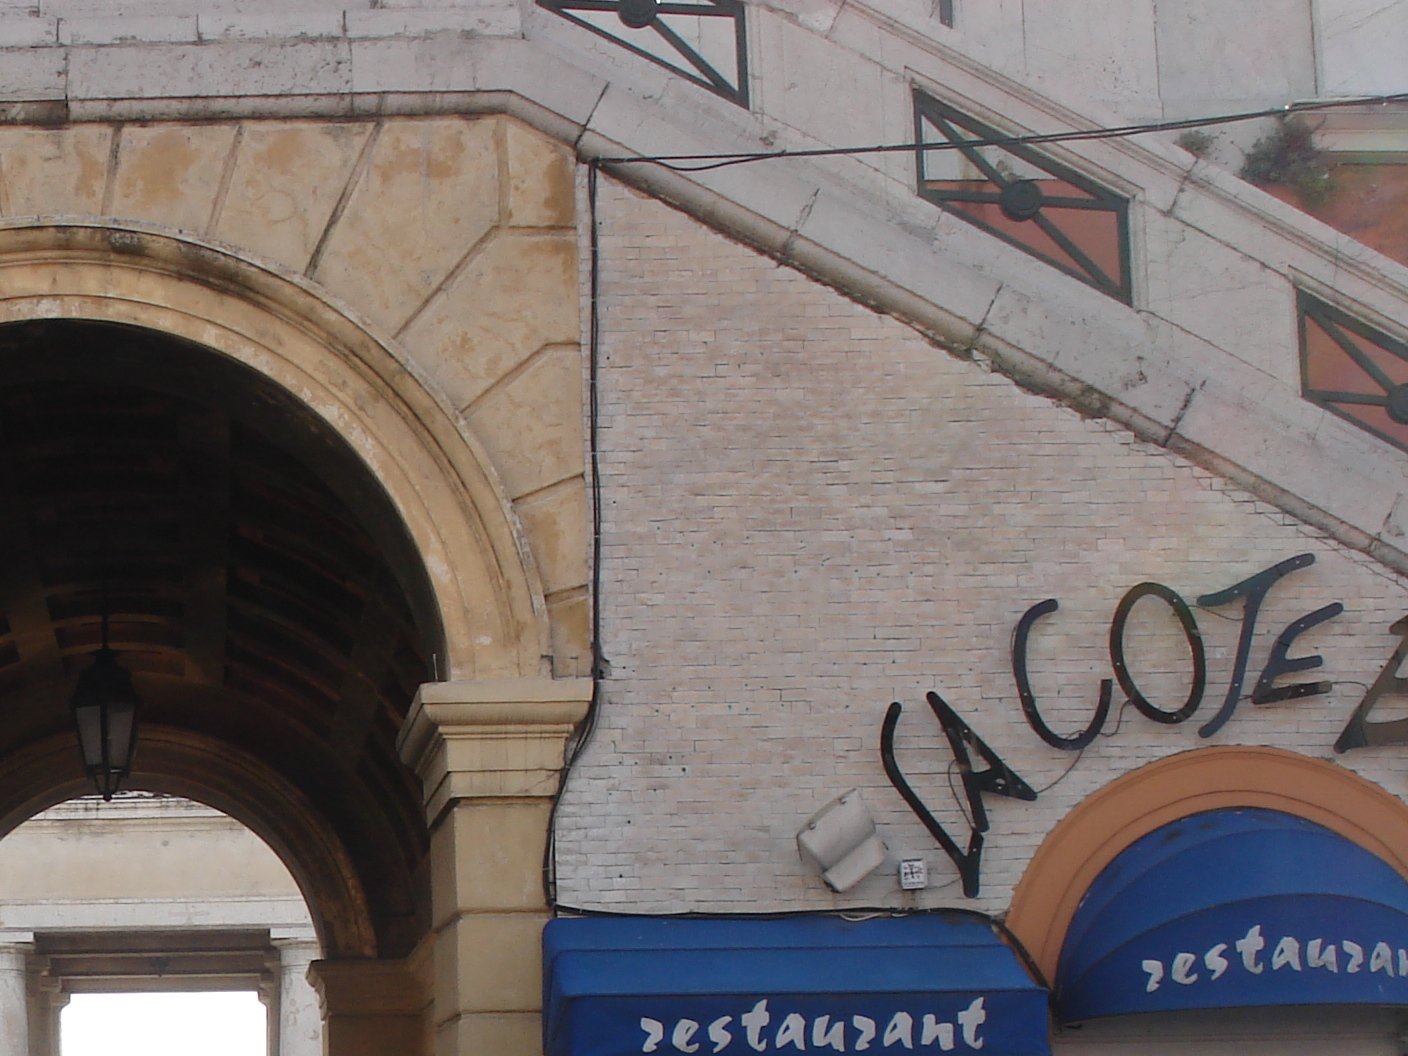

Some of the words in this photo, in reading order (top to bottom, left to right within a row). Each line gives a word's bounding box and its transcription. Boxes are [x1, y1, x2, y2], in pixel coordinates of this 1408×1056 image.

[880, 690, 1038, 898] LA
[1009, 552, 1344, 751] COTE
[639, 996, 986, 1054] restaurant
